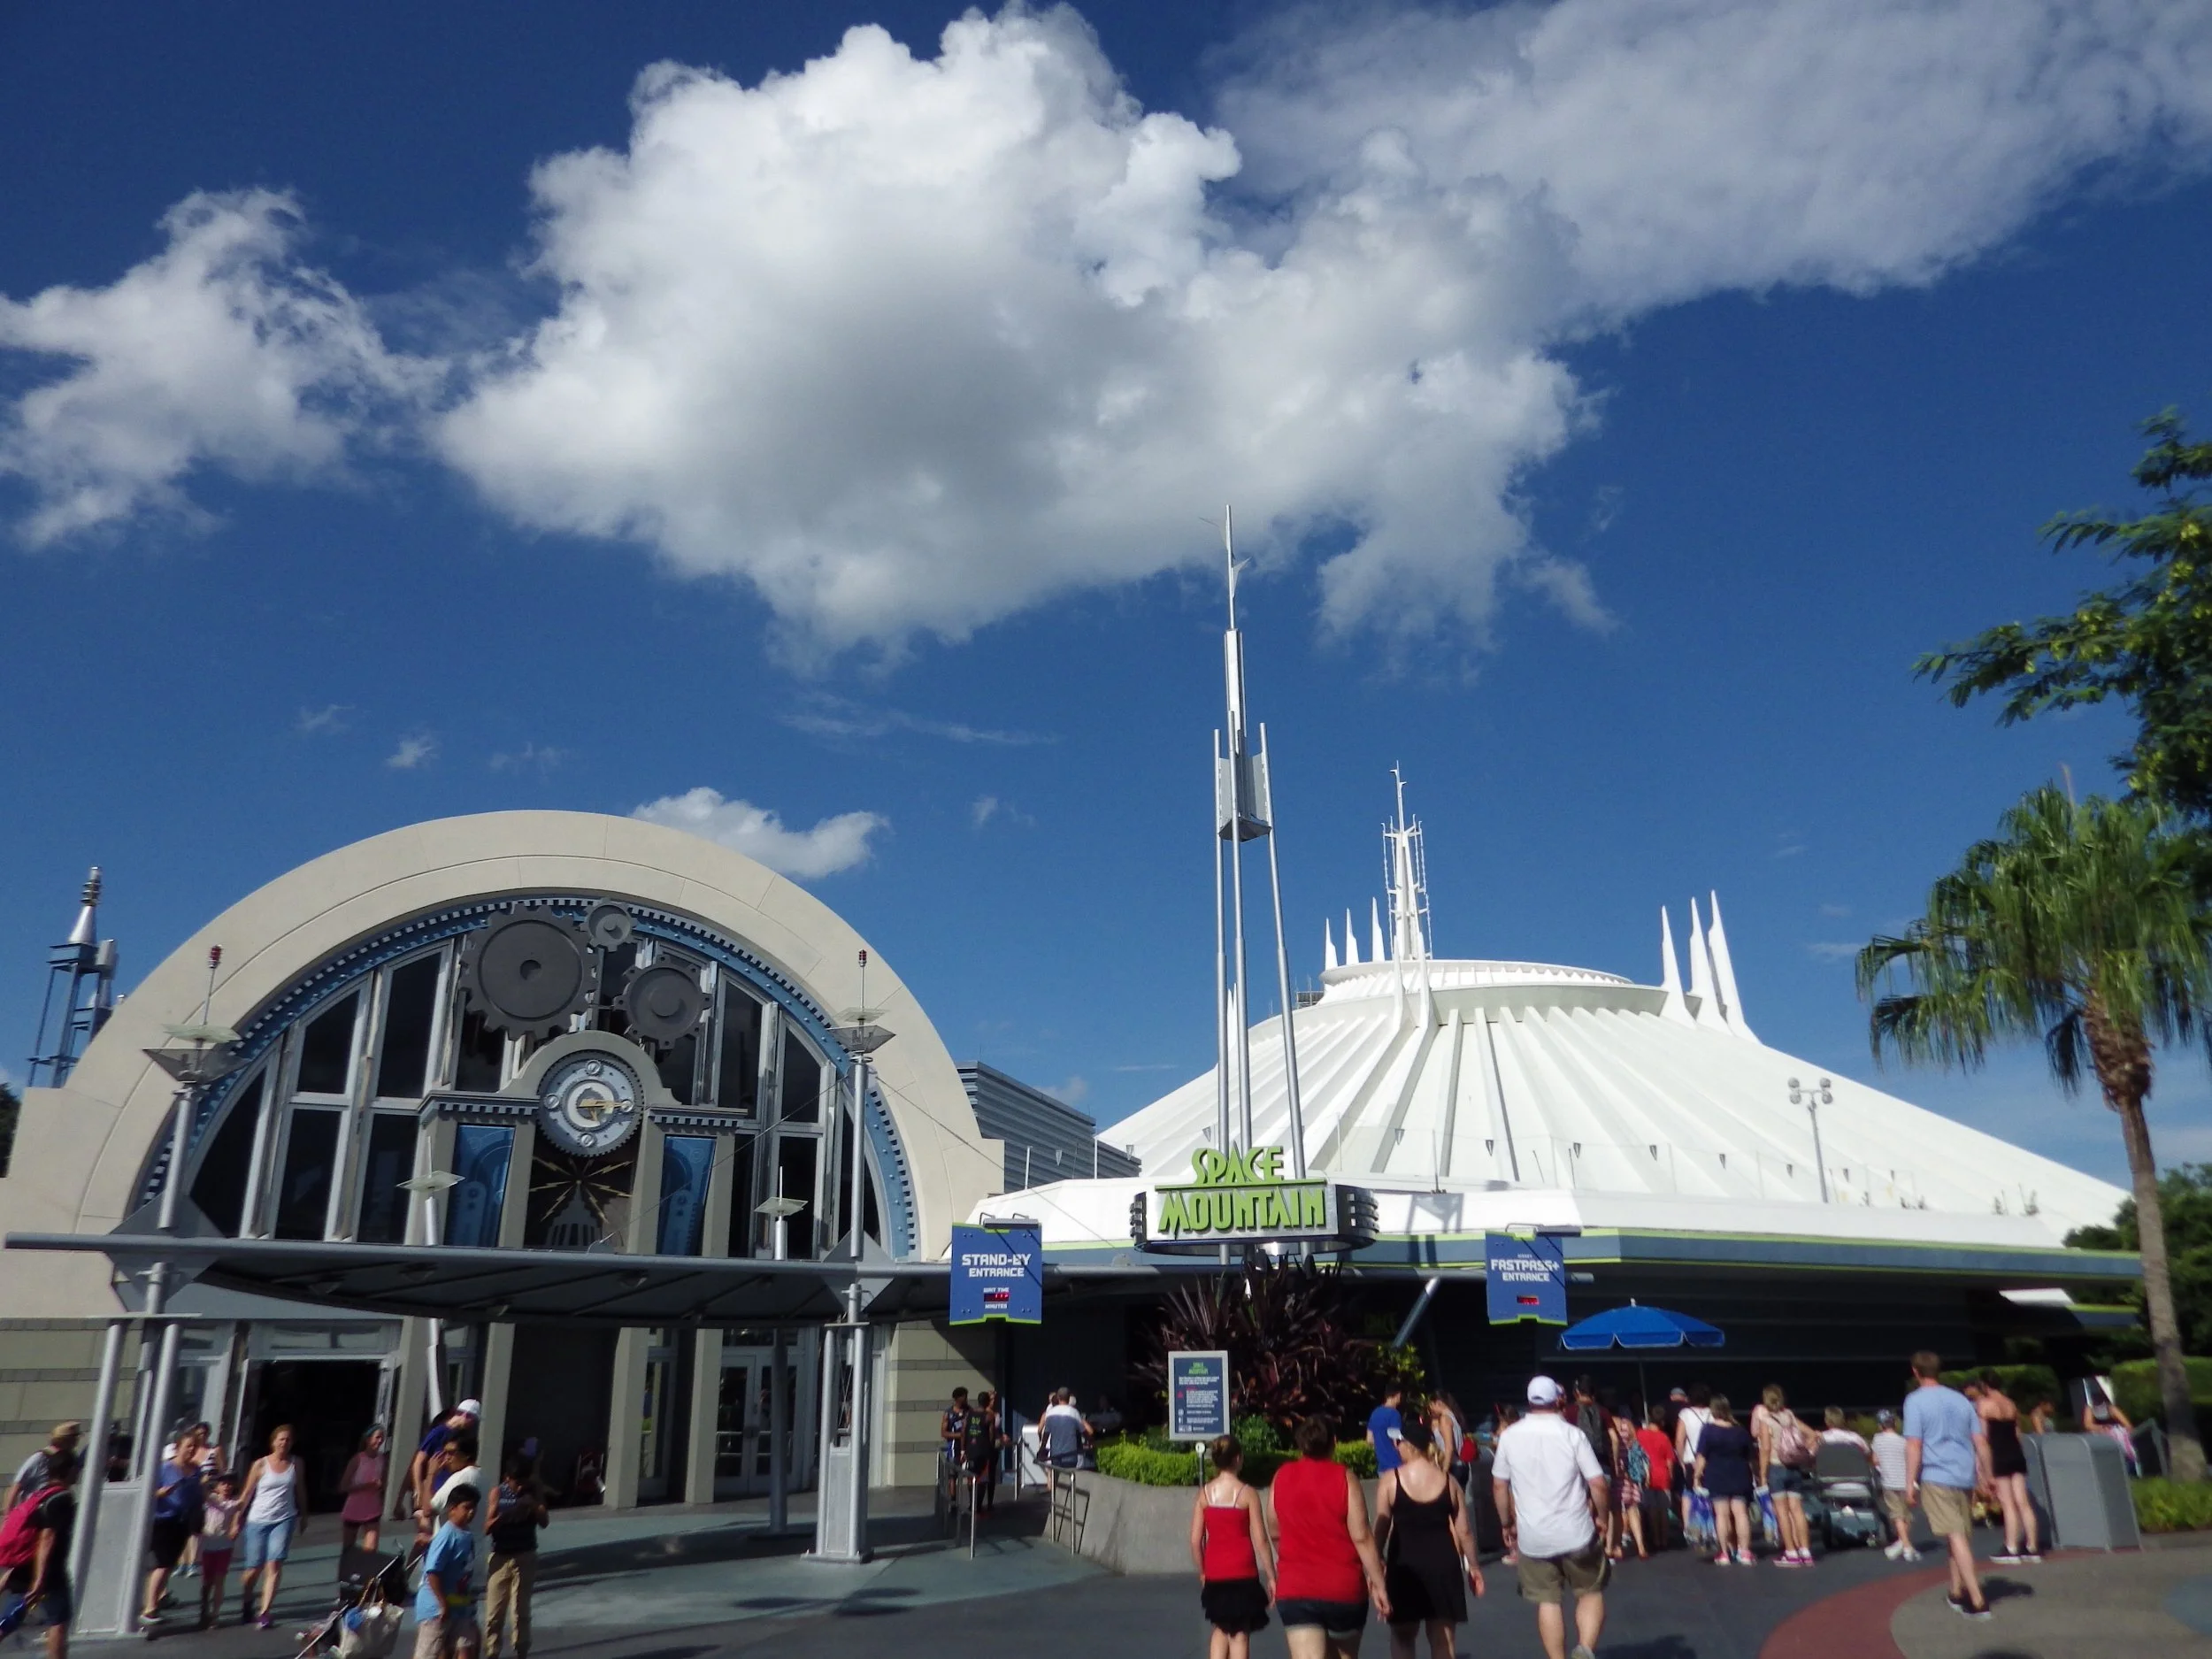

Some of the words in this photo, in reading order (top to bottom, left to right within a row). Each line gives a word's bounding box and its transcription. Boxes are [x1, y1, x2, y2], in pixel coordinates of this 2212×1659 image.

[1191, 1140, 1284, 1185] SPACE
[1157, 1187, 1325, 1234] MOUNTAIN
[962, 1253, 1032, 1266] STAND-BY
[1490, 1259, 1560, 1271] FASTPASS+
[969, 1267, 1025, 1278] ENTRANCE
[1502, 1272, 1550, 1282] ENTRANCE
